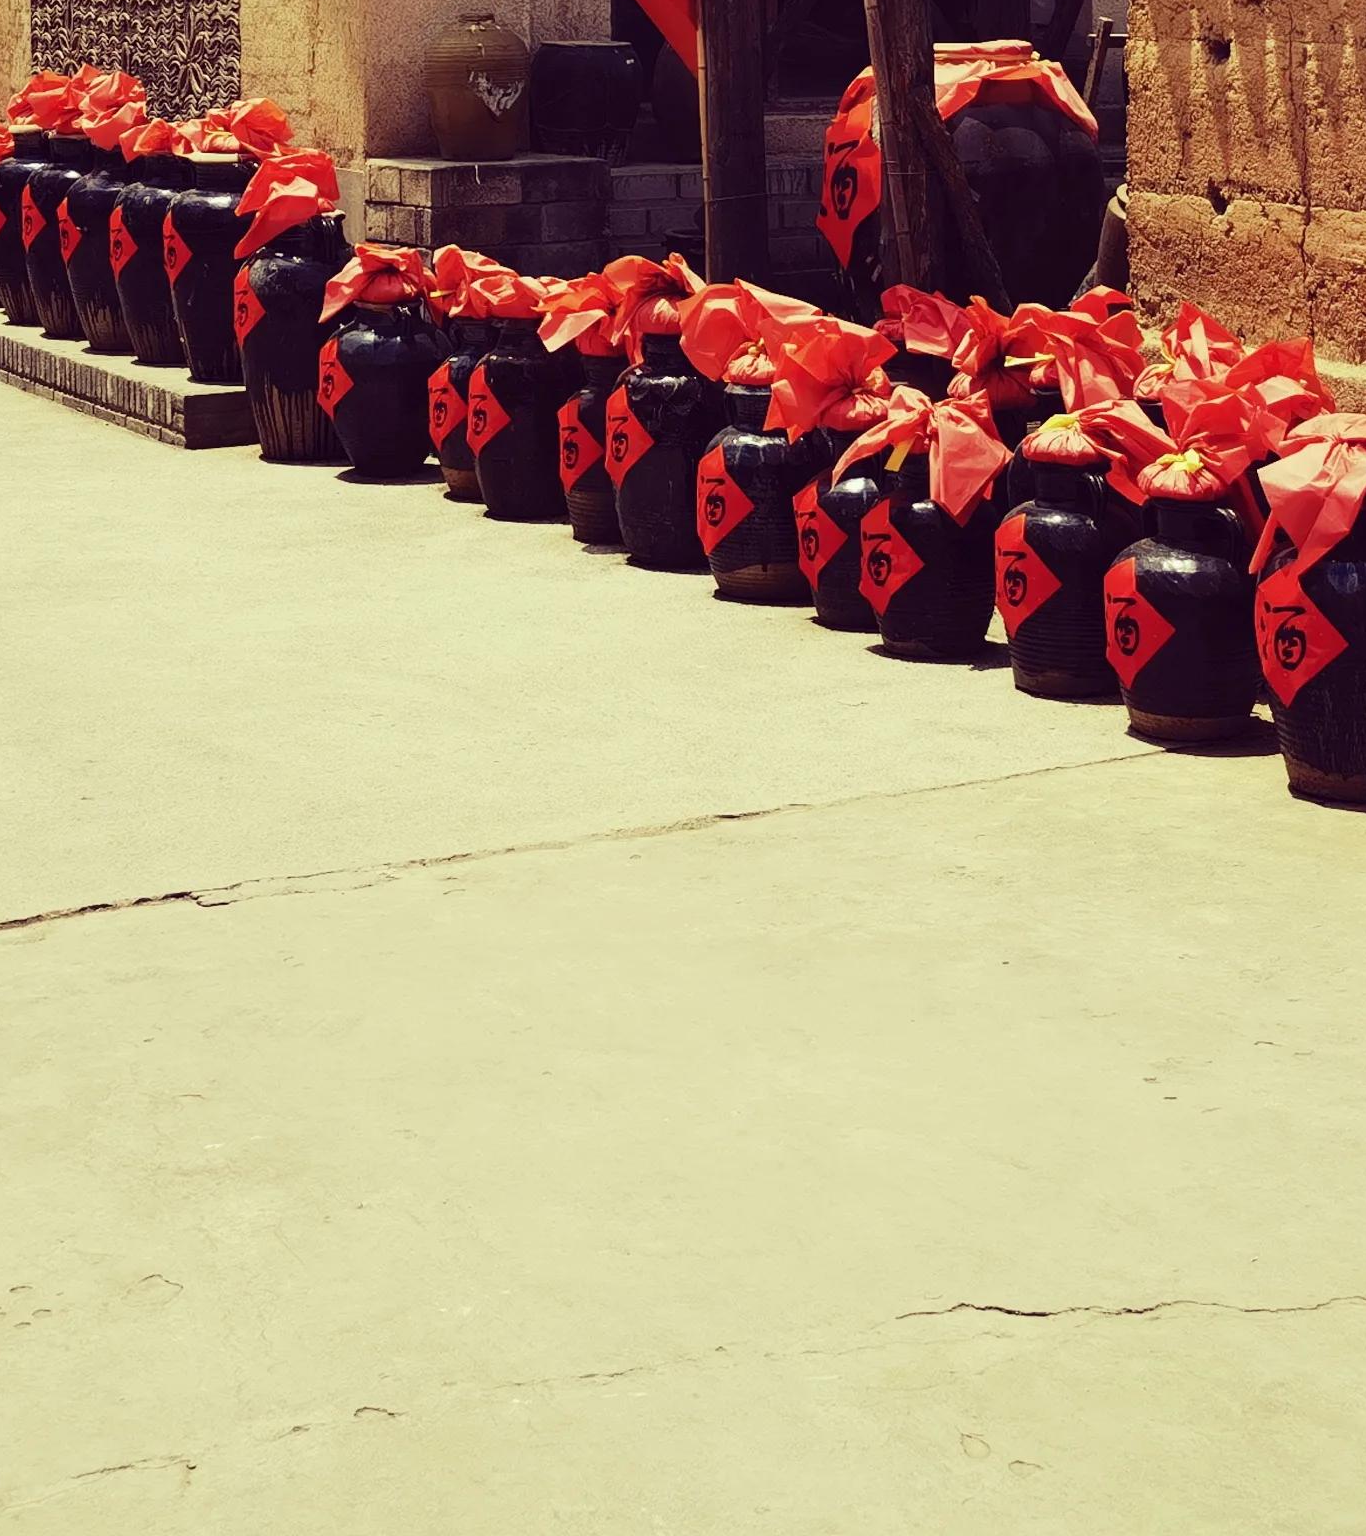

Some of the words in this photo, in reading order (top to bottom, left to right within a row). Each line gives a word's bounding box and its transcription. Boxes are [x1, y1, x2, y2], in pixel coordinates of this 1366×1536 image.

[819, 139, 859, 220] 酒
[430, 387, 449, 427] 酒
[608, 415, 629, 463] 酒
[700, 476, 726, 528] 酒
[861, 531, 892, 587] 酒
[997, 546, 1027, 607] 酒
[1106, 592, 1140, 656] 酒
[1260, 601, 1307, 671] 酒
